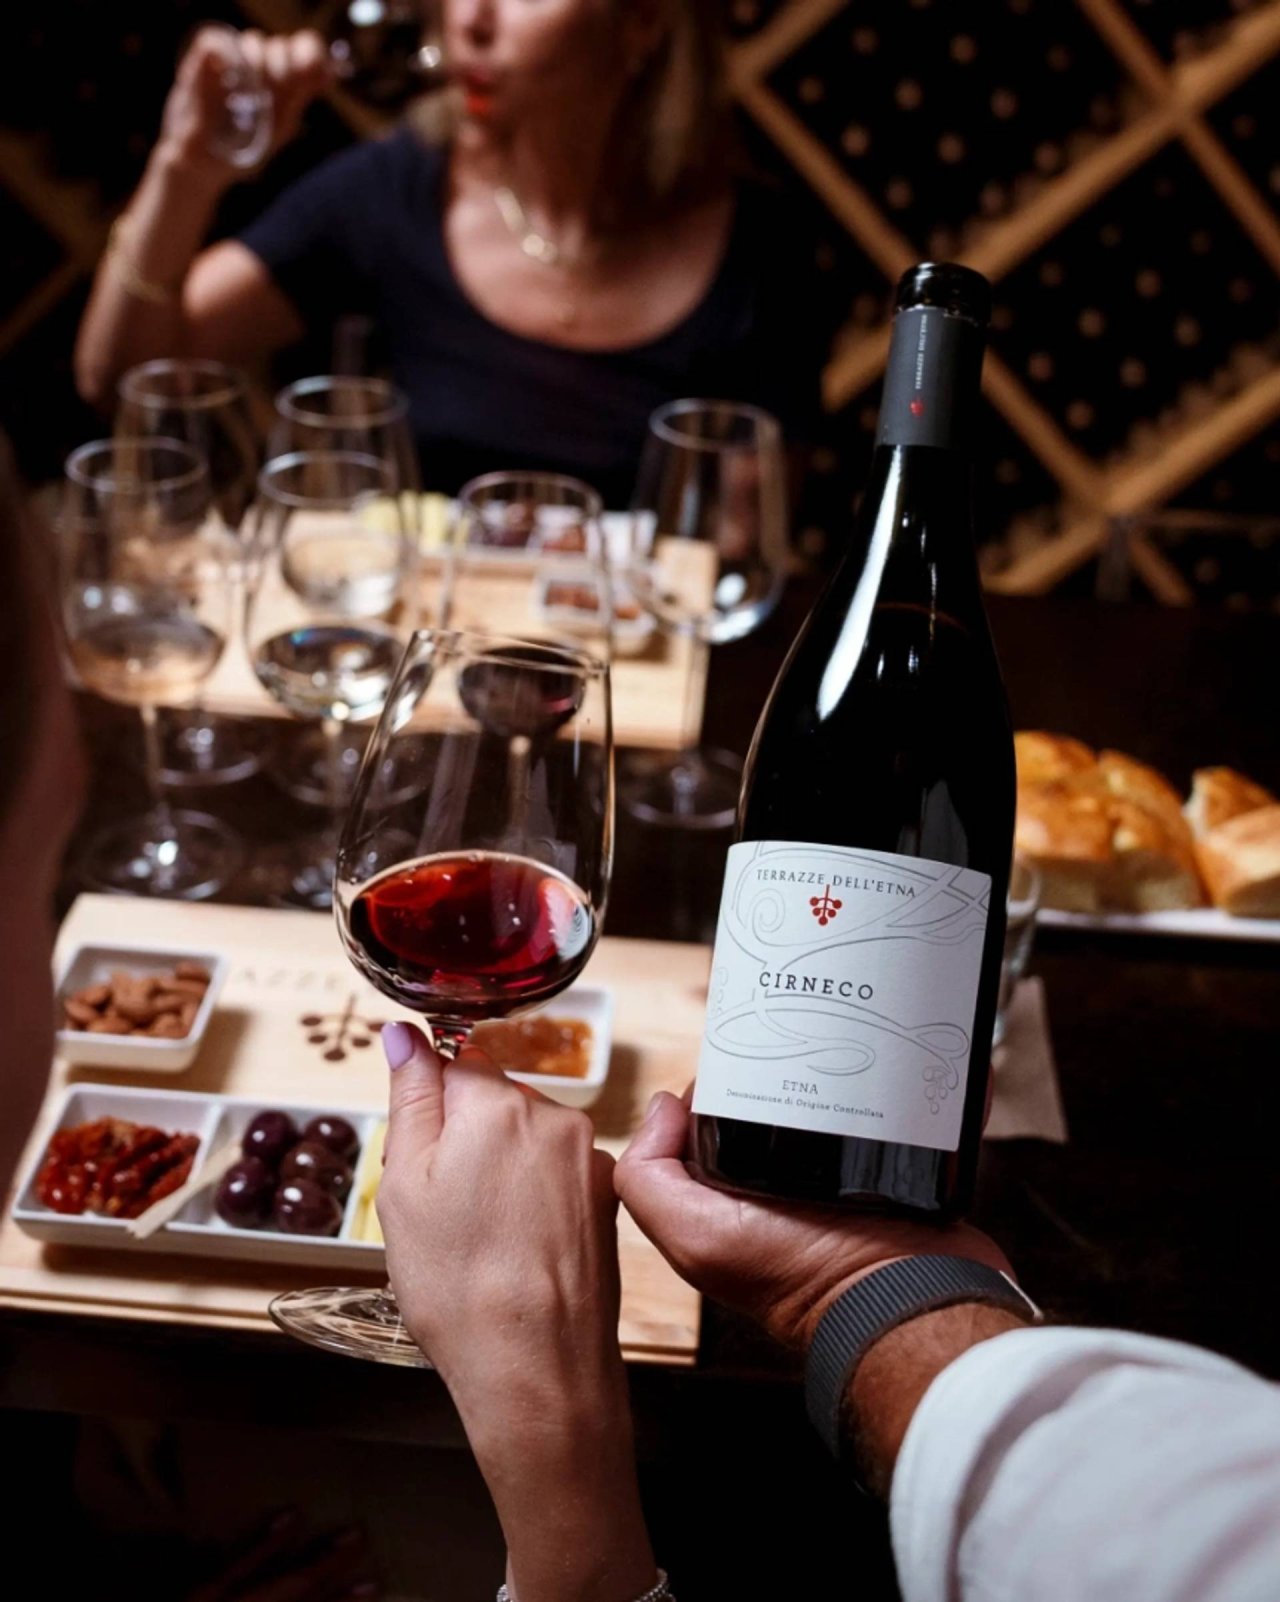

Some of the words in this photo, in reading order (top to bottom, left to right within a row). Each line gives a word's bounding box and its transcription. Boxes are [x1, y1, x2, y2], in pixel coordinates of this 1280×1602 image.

[756, 868, 825, 885] TERRAZZE
[832, 874, 917, 898] DELL'ETNA
[759, 971, 874, 1000] CIRNECO
[782, 1079, 819, 1095] ETNA
[726, 1088, 782, 1104] Denominazione
[784, 1096, 794, 1105] di
[796, 1098, 830, 1111] Origine
[833, 1104, 884, 1119] Controllata
